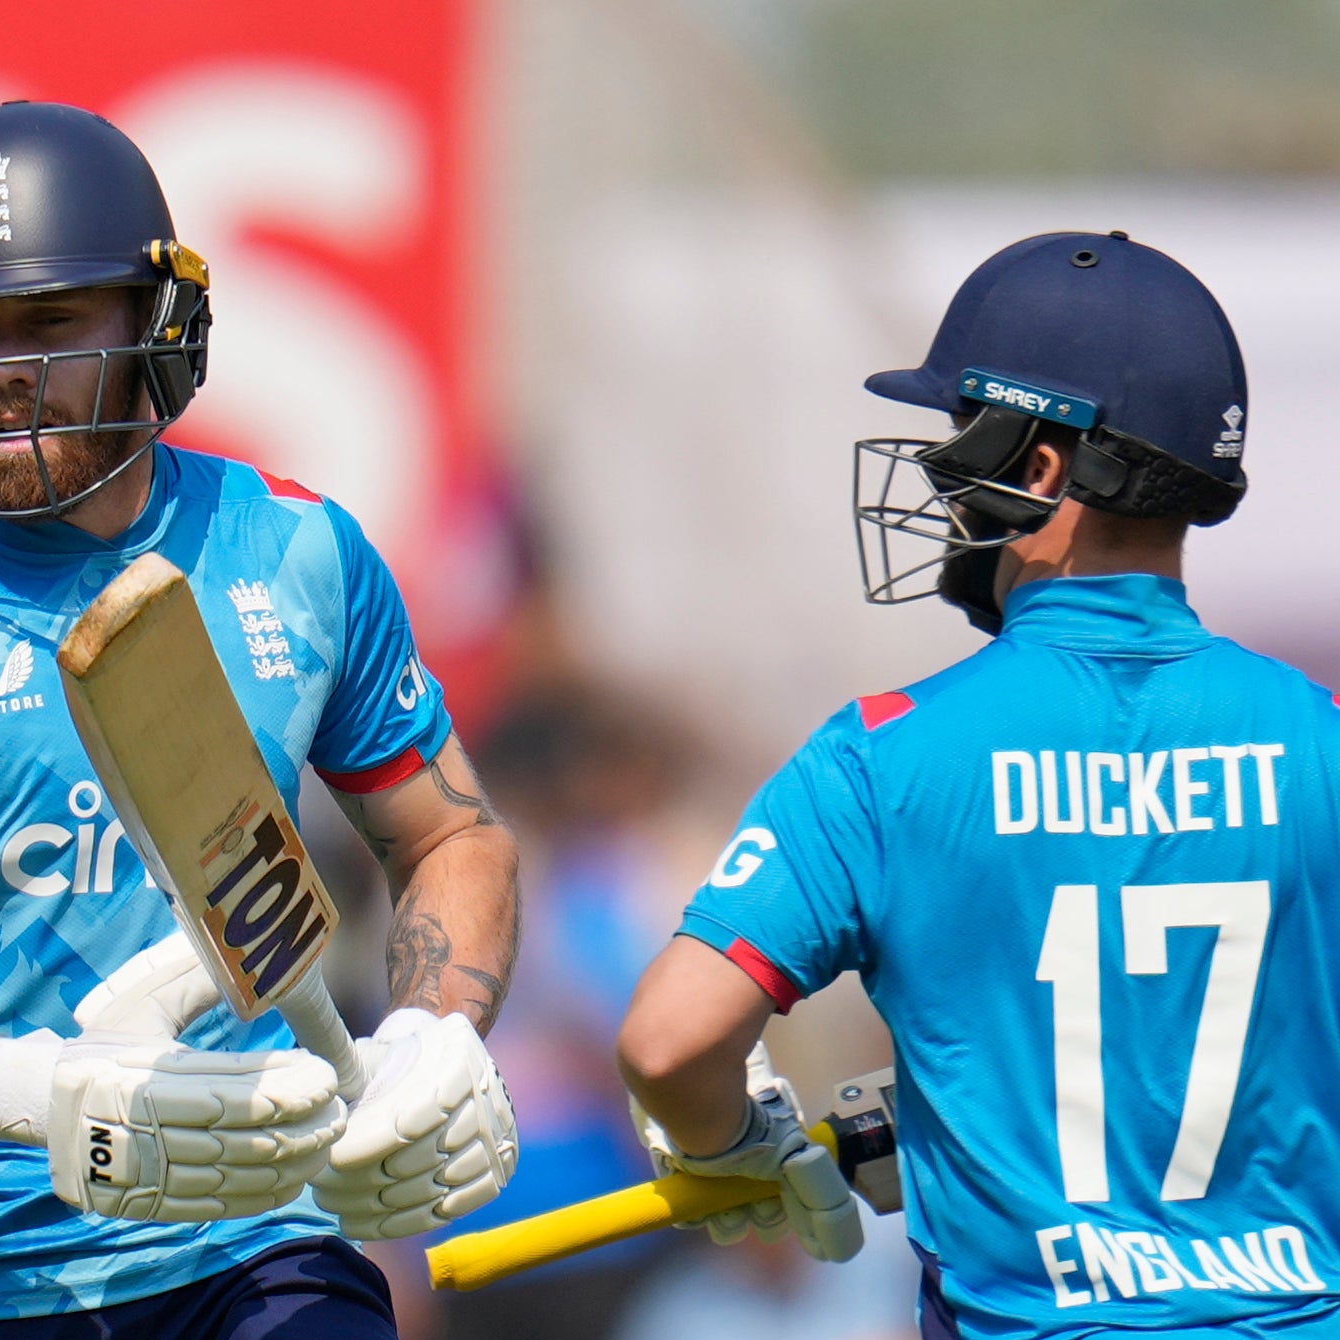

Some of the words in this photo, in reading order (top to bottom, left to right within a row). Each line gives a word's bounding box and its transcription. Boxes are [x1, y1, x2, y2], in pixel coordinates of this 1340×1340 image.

[984, 382, 1051, 412] SHREY
[991, 744, 1285, 836] DUCKETT
[699, 827, 777, 888] G
[206, 812, 326, 999] TON
[1035, 880, 1271, 1202] 17
[89, 1126, 112, 1182] TON
[1035, 1223, 1327, 1308] ENGLAND
